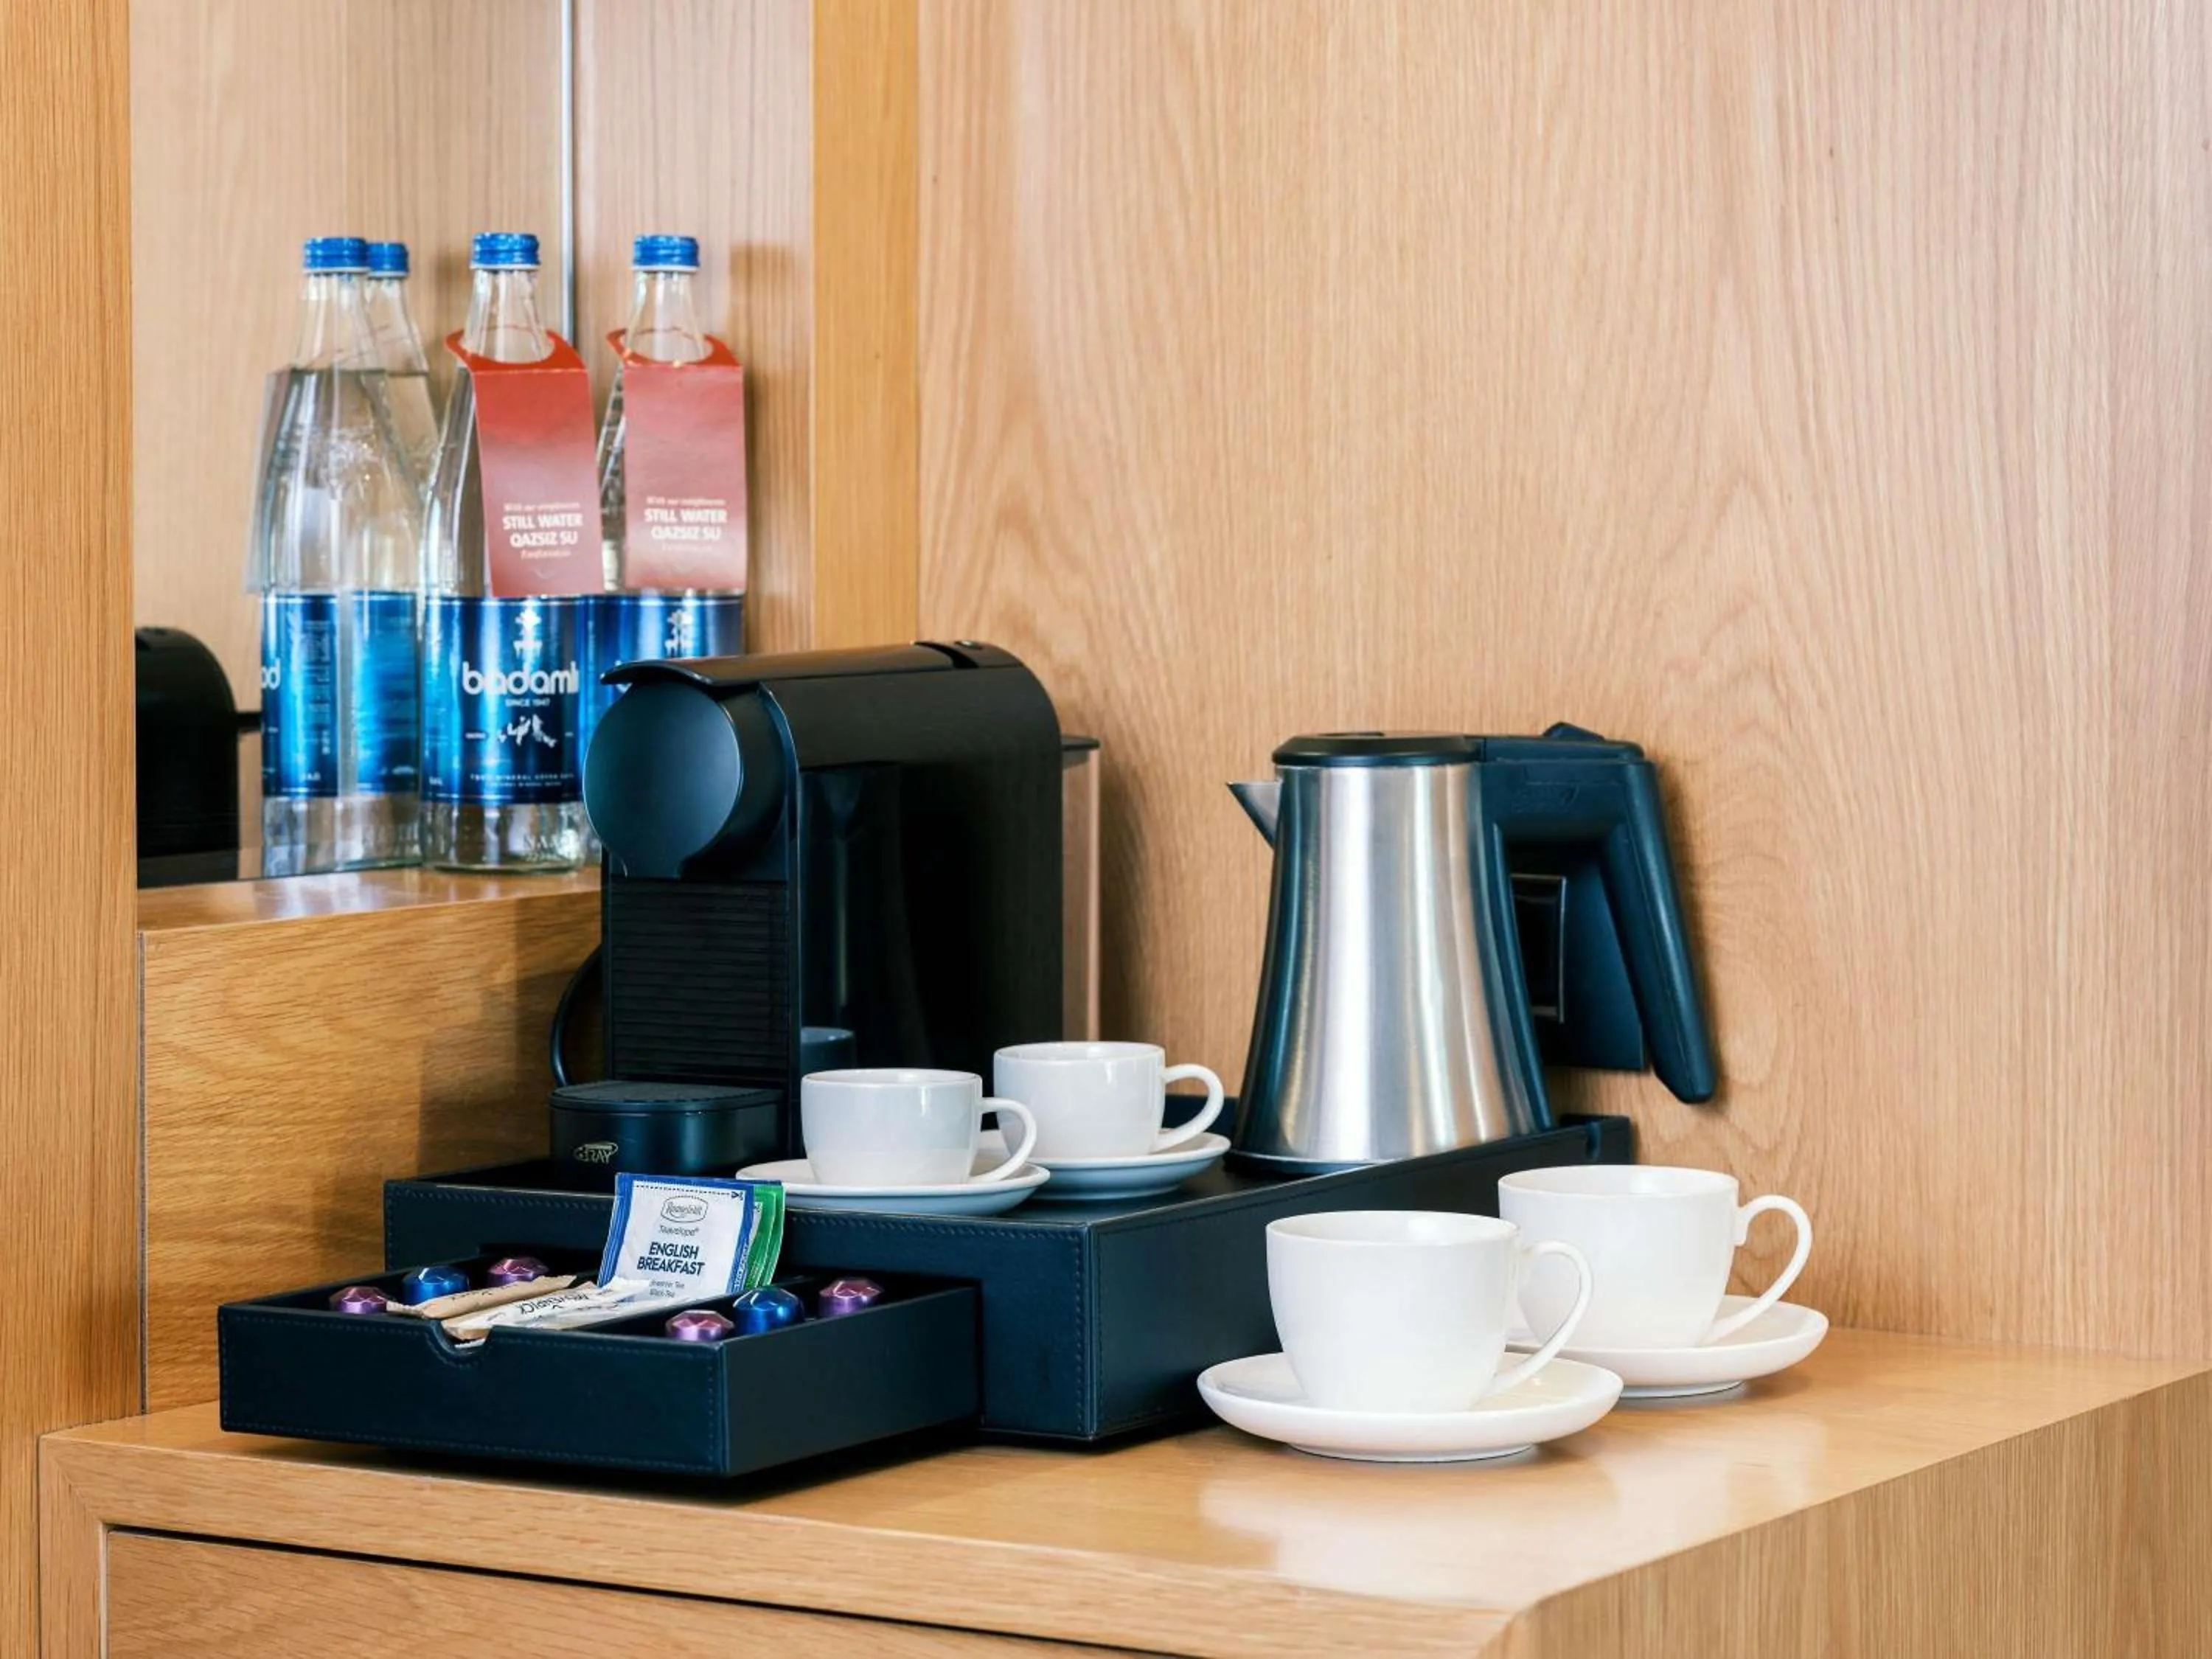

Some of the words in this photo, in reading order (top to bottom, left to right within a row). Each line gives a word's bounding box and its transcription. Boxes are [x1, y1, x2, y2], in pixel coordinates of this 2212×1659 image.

[502, 515, 536, 531] STILL
[538, 513, 583, 529] WATER
[644, 508, 677, 523] STILL
[680, 508, 728, 523] WATER
[509, 531, 558, 548] QAZSIZ
[560, 530, 578, 546] SU
[702, 525, 722, 540] SU
[648, 1242, 699, 1259] ENGLISH
[636, 1256, 705, 1276] BREAKFAST
